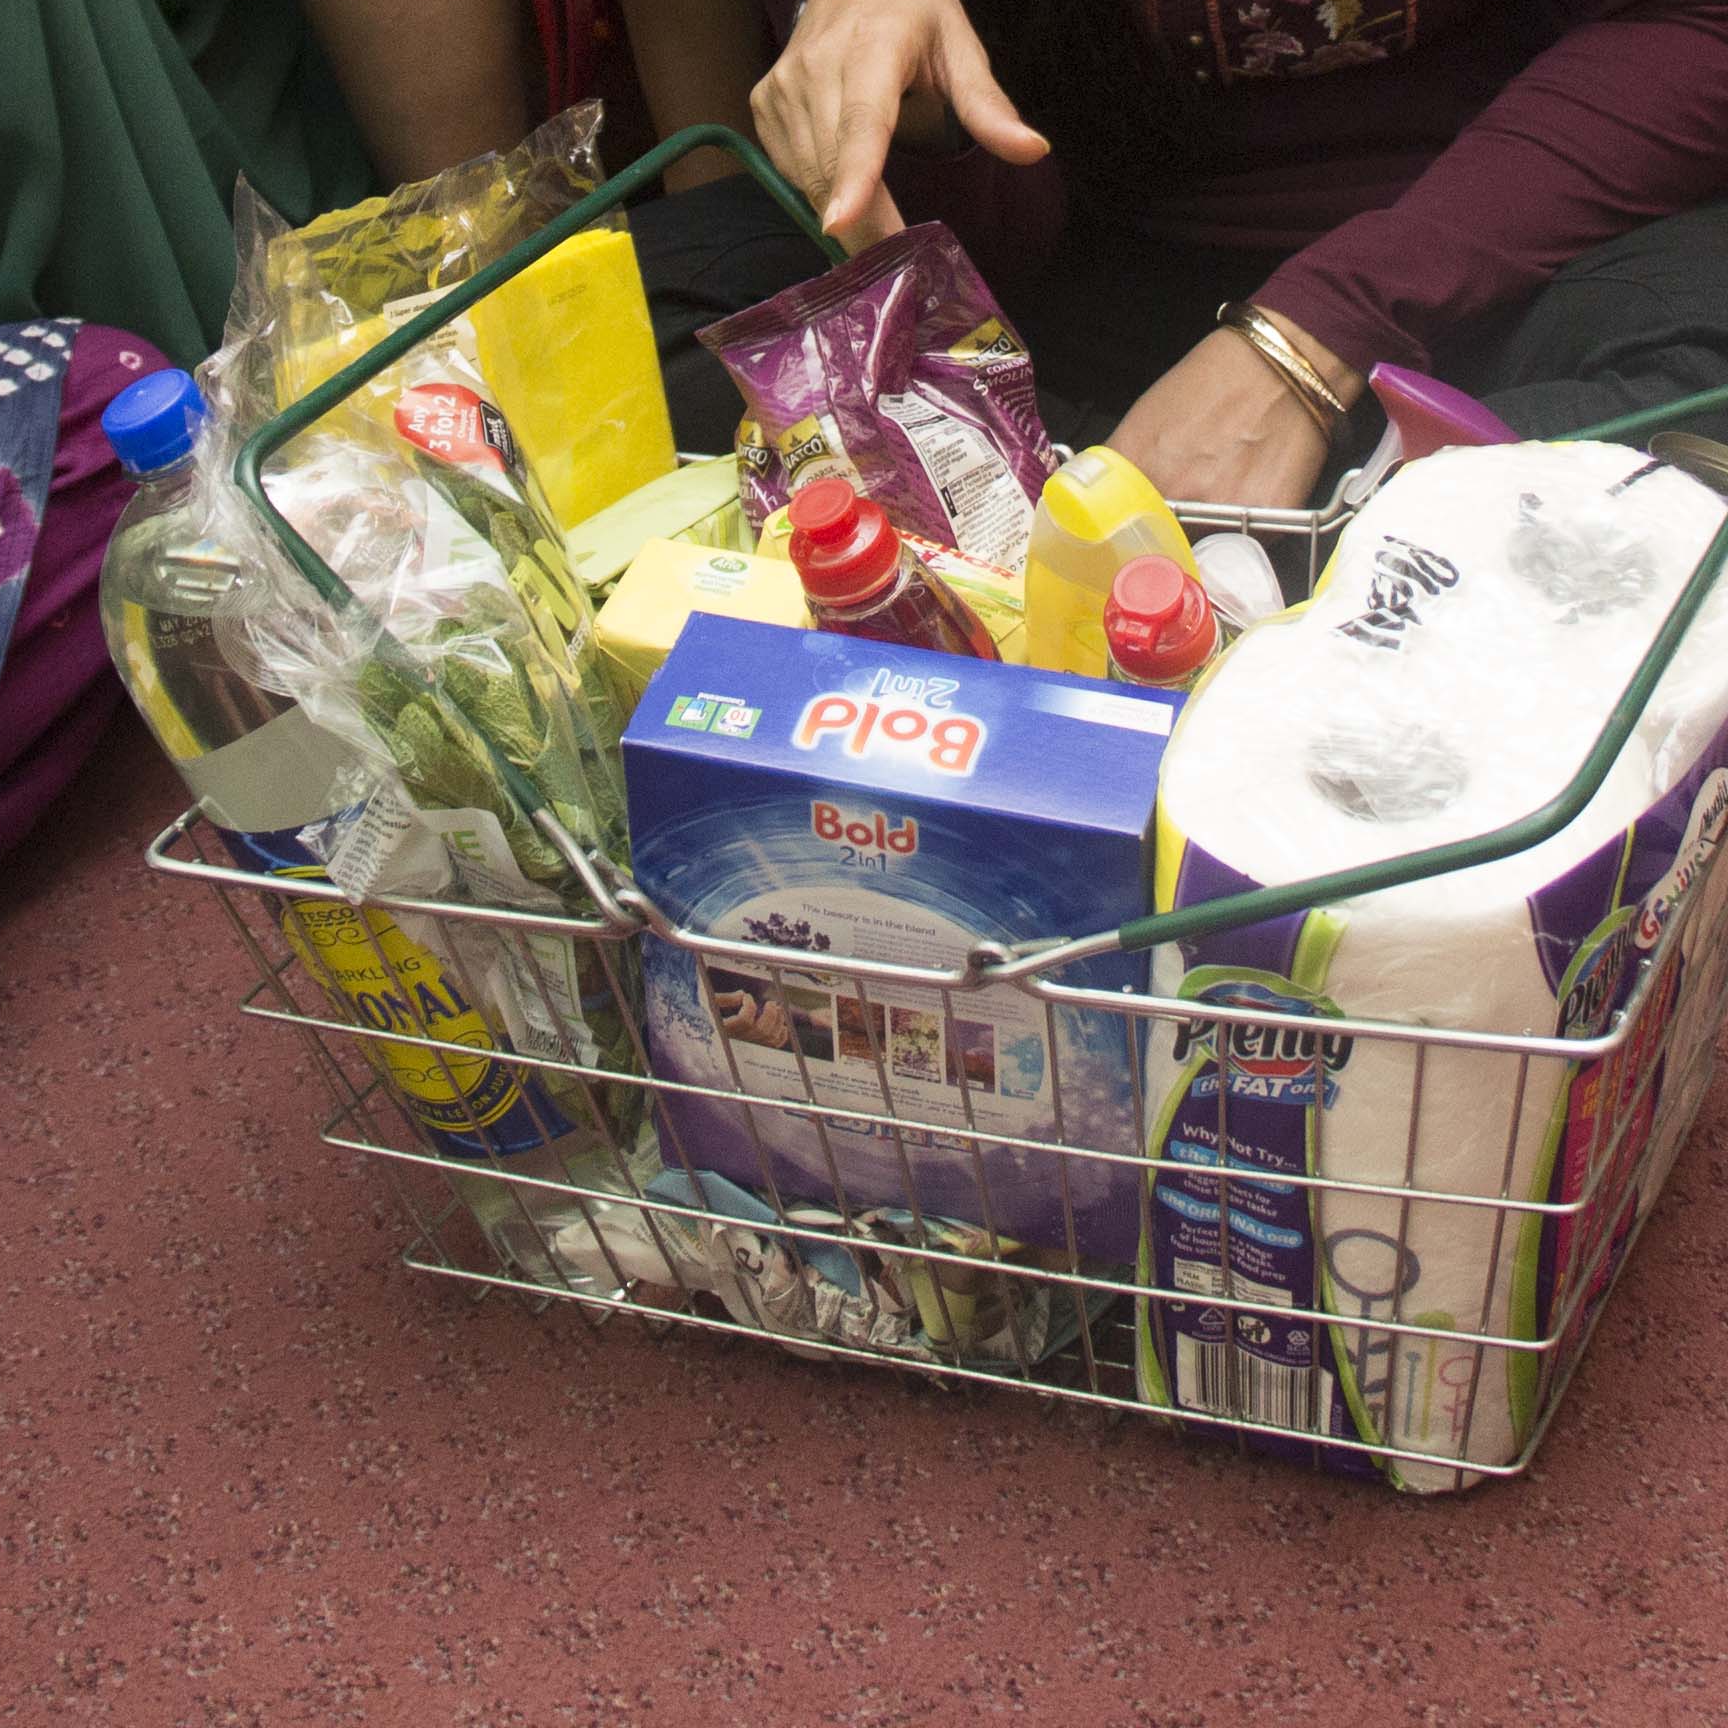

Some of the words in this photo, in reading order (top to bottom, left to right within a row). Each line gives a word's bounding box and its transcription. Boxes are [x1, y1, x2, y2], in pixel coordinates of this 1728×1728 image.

[973, 367, 1033, 396] SMOLIN
[434, 395, 456, 407] 2
[408, 405, 431, 434] Any
[430, 410, 455, 436] for
[429, 439, 451, 451] 3
[784, 437, 823, 470] NATCO
[797, 694, 984, 774] Bold
[811, 800, 918, 855] Bold
[839, 845, 888, 873] 2in1
[301, 907, 354, 923] TESCO
[801, 903, 819, 915] The
[823, 908, 860, 923] beauty
[873, 916, 883, 926] in
[885, 919, 904, 931] the
[905, 922, 937, 936] blend
[333, 956, 421, 983] ARKLNG
[1232, 1076, 1293, 1098] FAT
[447, 1093, 491, 1118] LEON
[1182, 1122, 1219, 1146] Why
[1187, 1205, 1265, 1238] ORIINAL
[1267, 1231, 1299, 1246] one
